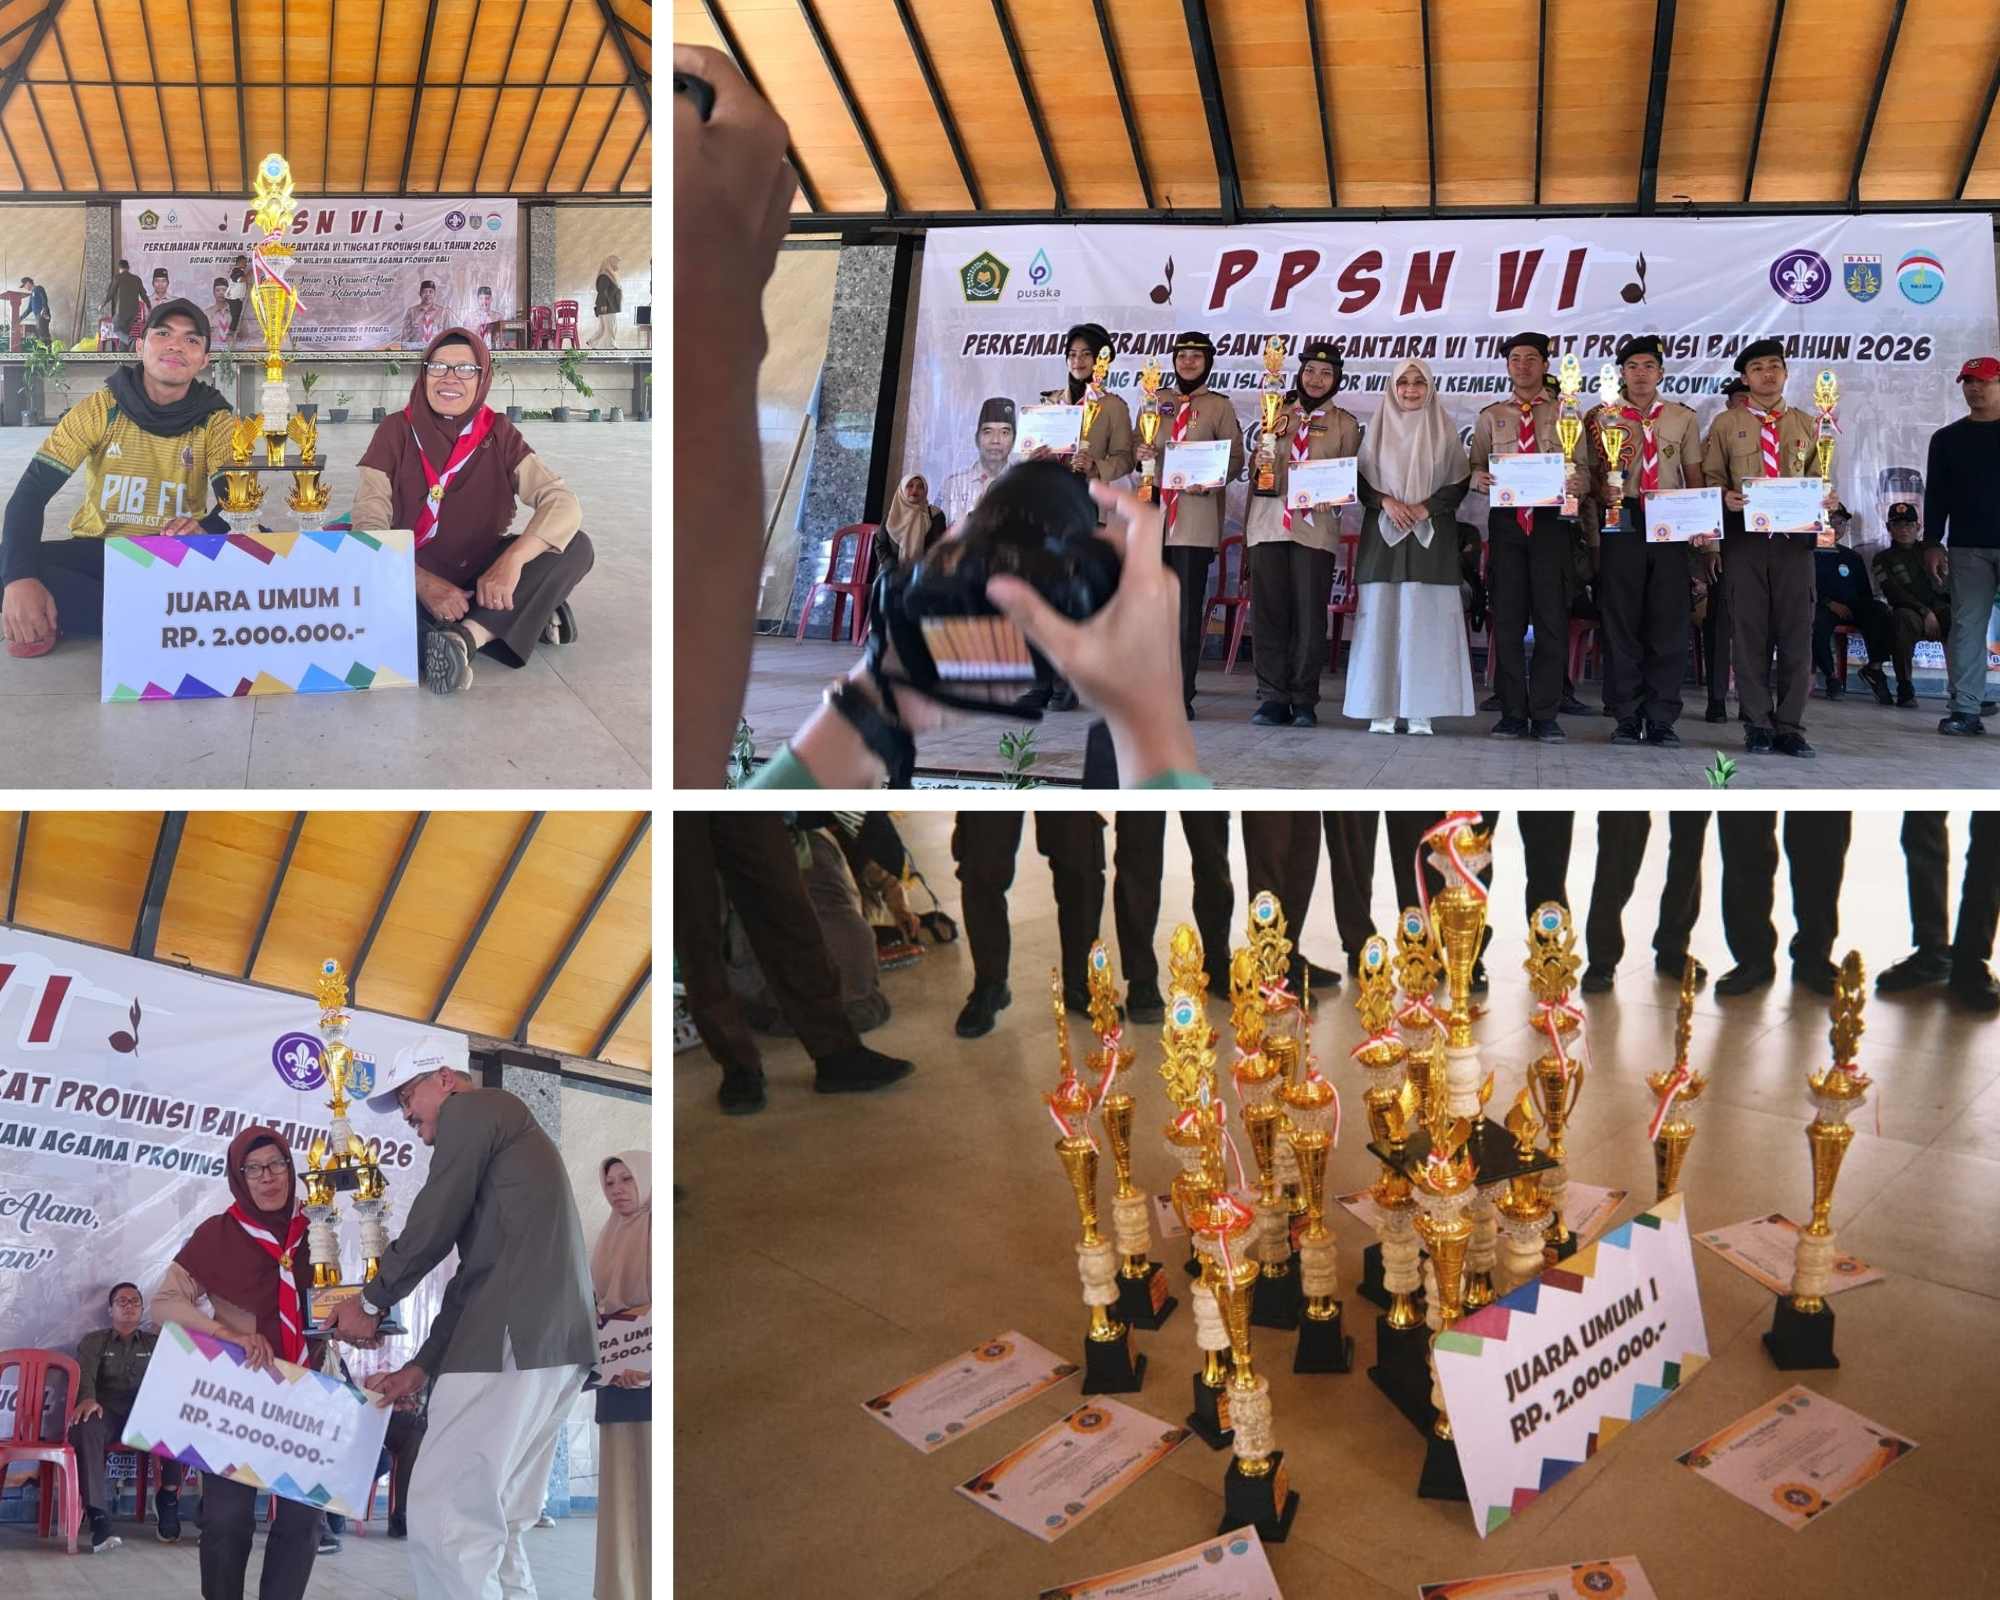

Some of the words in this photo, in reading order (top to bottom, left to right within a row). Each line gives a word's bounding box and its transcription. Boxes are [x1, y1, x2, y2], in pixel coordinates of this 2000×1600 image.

[243, 209, 336, 235] PSN
[350, 210, 383, 234] VI
[143, 242, 200, 251] PERKEMAHAN
[201, 242, 244, 251] PRAMUKA
[343, 242, 380, 251] TINGKAT
[381, 242, 421, 251] PROVINSI
[423, 241, 441, 250] BALI
[444, 241, 472, 250] TAHUN
[472, 241, 497, 250] 2026
[1016, 288, 1061, 300] pusaka
[1208, 248, 1456, 316] PPSN
[1496, 248, 1588, 312] VI
[1445, 336, 1467, 358] VI
[1856, 335, 1932, 361] 2026
[101, 474, 148, 513] PIB
[165, 589, 251, 617] JUARA
[258, 586, 340, 610] UMUM
[354, 586, 361, 606] I
[161, 626, 206, 649] RP.
[212, 623, 365, 647] 2.000.000.-
[353, 1053, 373, 1062] ALI
[55, 1081, 195, 1129] PROVINSI
[39, 1129, 130, 1162] AGAMA
[1503, 1331, 1580, 1403] JUARA
[1579, 1288, 1645, 1349] UMUM
[1649, 1277, 1659, 1302] I
[1509, 1406, 1552, 1445] RP.
[1553, 1321, 1668, 1415] 2.000.000.-
[190, 1378, 255, 1414] JUARA
[260, 1401, 325, 1437] UMUM
[178, 1404, 212, 1429] RP.
[216, 1418, 335, 1466] 2.000.000.-
